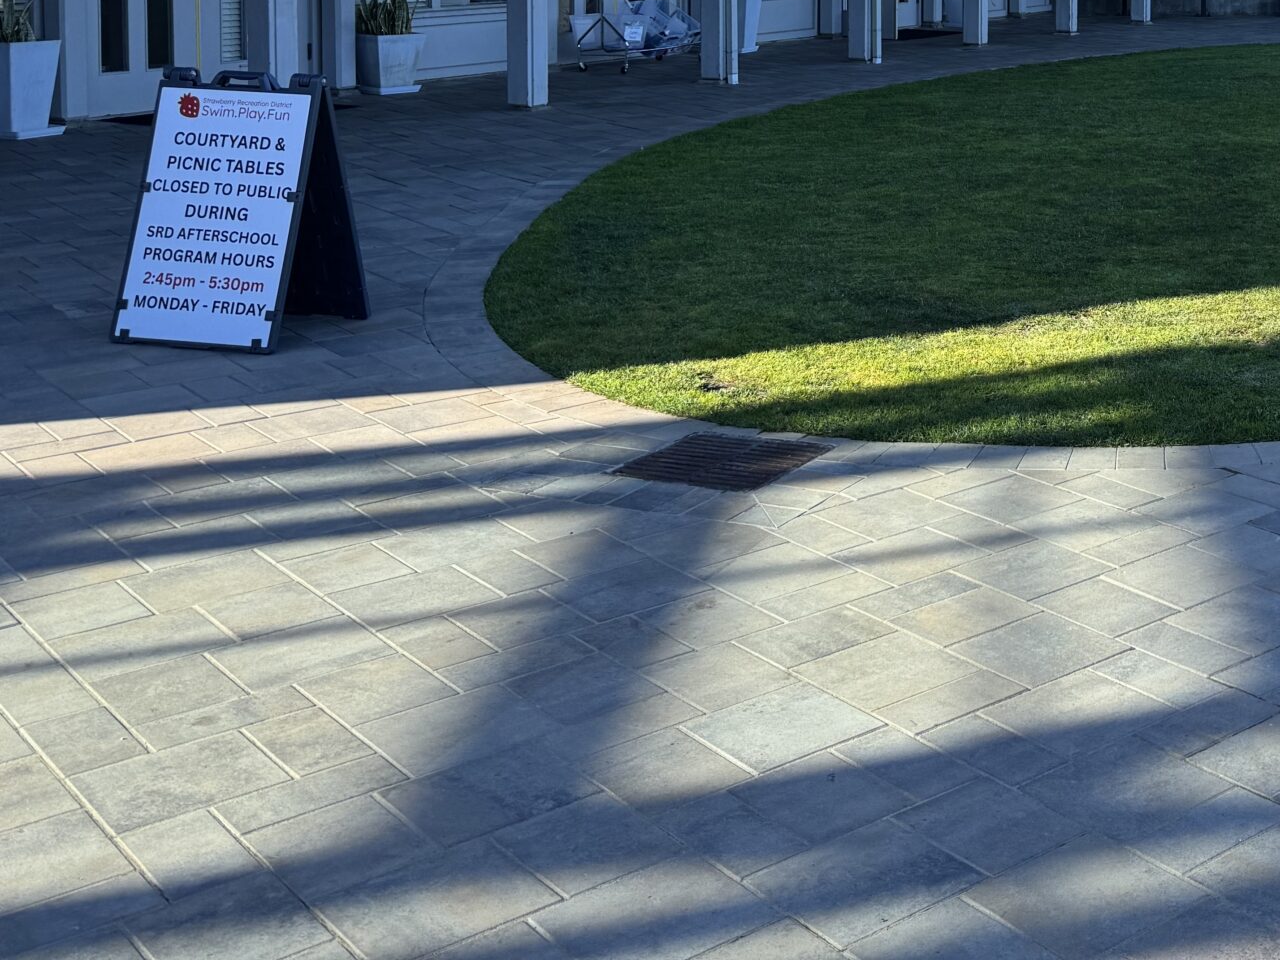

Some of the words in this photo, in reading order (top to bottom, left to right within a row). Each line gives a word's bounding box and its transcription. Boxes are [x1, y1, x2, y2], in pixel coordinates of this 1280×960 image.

[201, 105, 290, 122] Swim.Play.Fun
[203, 97, 236, 107] Strawberry
[237, 99, 269, 108] Recreation
[271, 101, 293, 109] District
[174, 131, 271, 150] COURTYARD
[275, 137, 286, 151] &
[167, 155, 221, 172] PICNIC
[226, 159, 285, 176] TABLES
[152, 178, 210, 194] CLOSED
[214, 182, 233, 196] TO
[237, 184, 292, 200] PUBLIC
[184, 204, 249, 221] DURING
[146, 225, 174, 239] SRD
[177, 228, 279, 246] AFTERSCHOOL
[143, 247, 217, 265] PROGRAM
[221, 252, 275, 269] HOURS
[142, 271, 196, 290] 2:45pm
[209, 276, 264, 294] 5:30pm
[133, 294, 200, 312] MONDAY
[211, 300, 267, 317] FRIDAY
